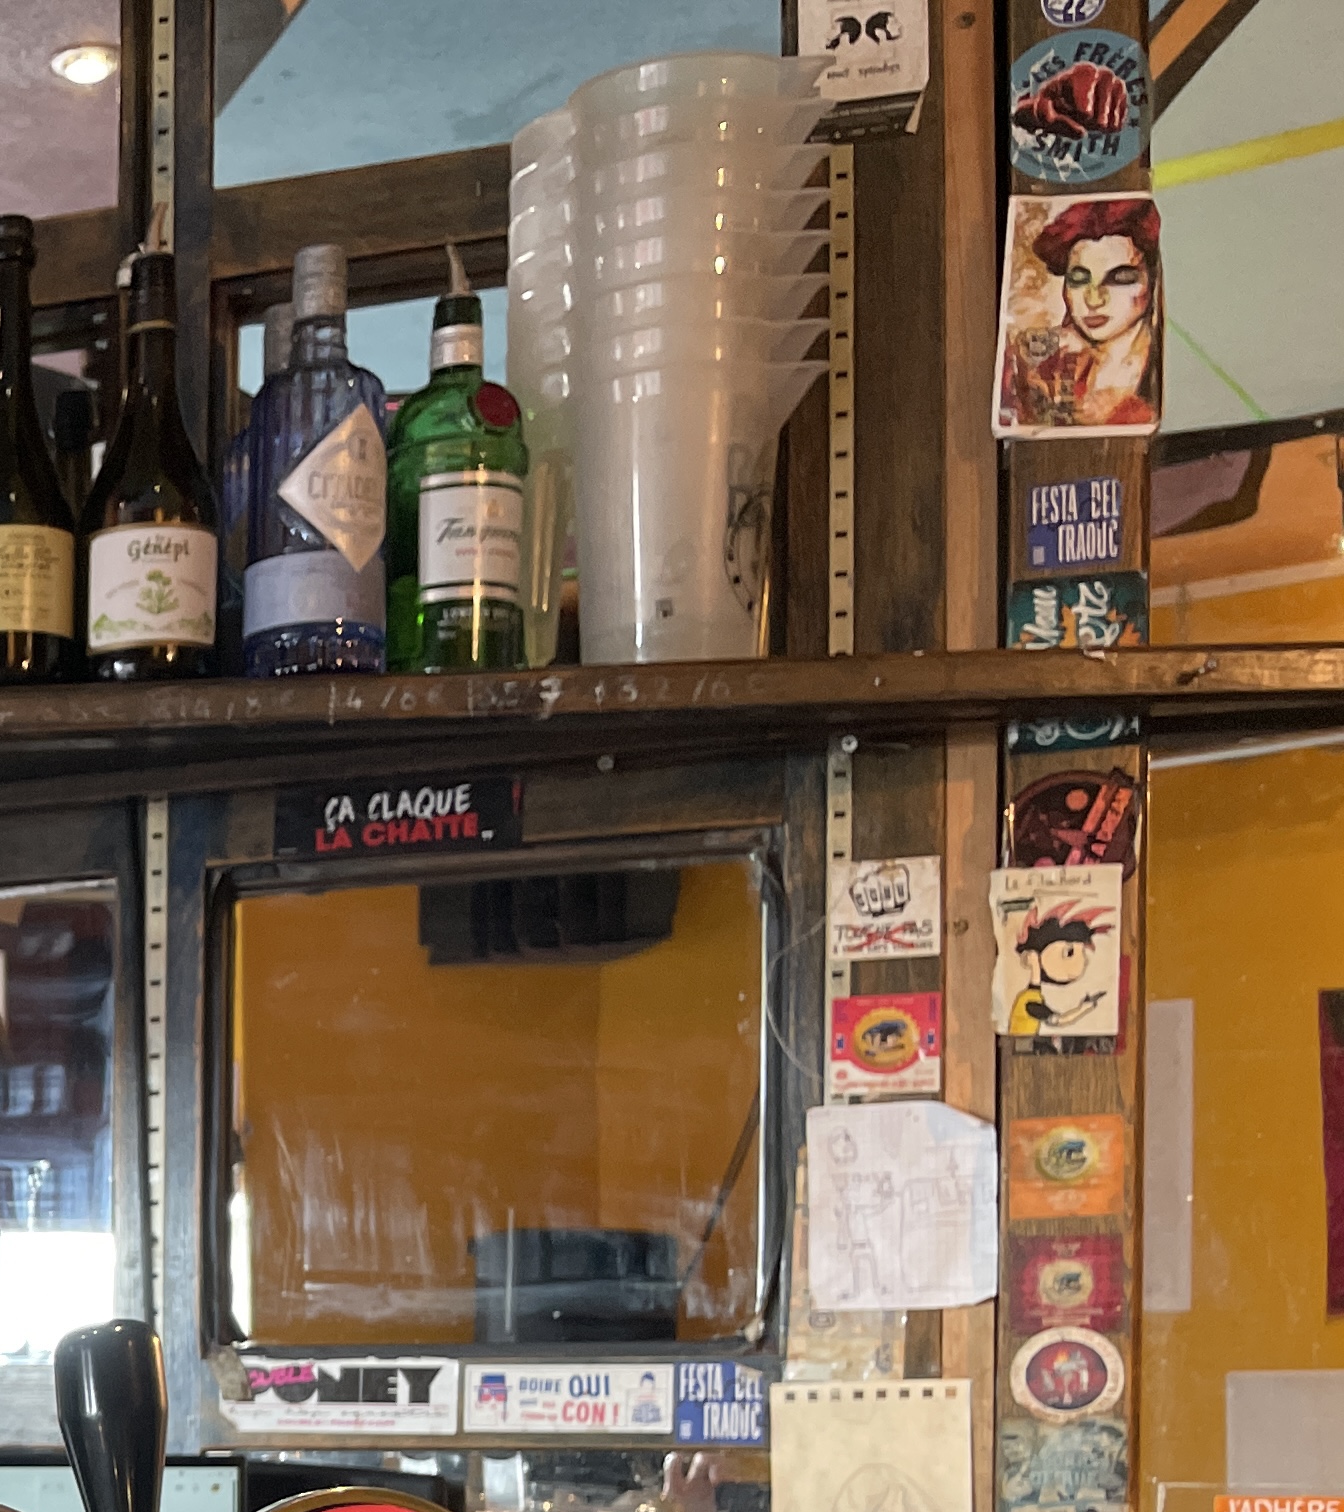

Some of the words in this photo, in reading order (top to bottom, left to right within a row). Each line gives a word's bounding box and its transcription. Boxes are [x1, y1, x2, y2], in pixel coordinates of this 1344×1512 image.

[1033, 134, 1122, 161] SMITH
[1032, 484, 1078, 525] FESTA
[367, 784, 472, 820] CLAQUE
[315, 827, 352, 852] LA
[363, 812, 480, 847] CHATTE
[569, 1375, 610, 1398] OUI
[678, 1363, 723, 1400] FESTA
[562, 1401, 607, 1425] CON
